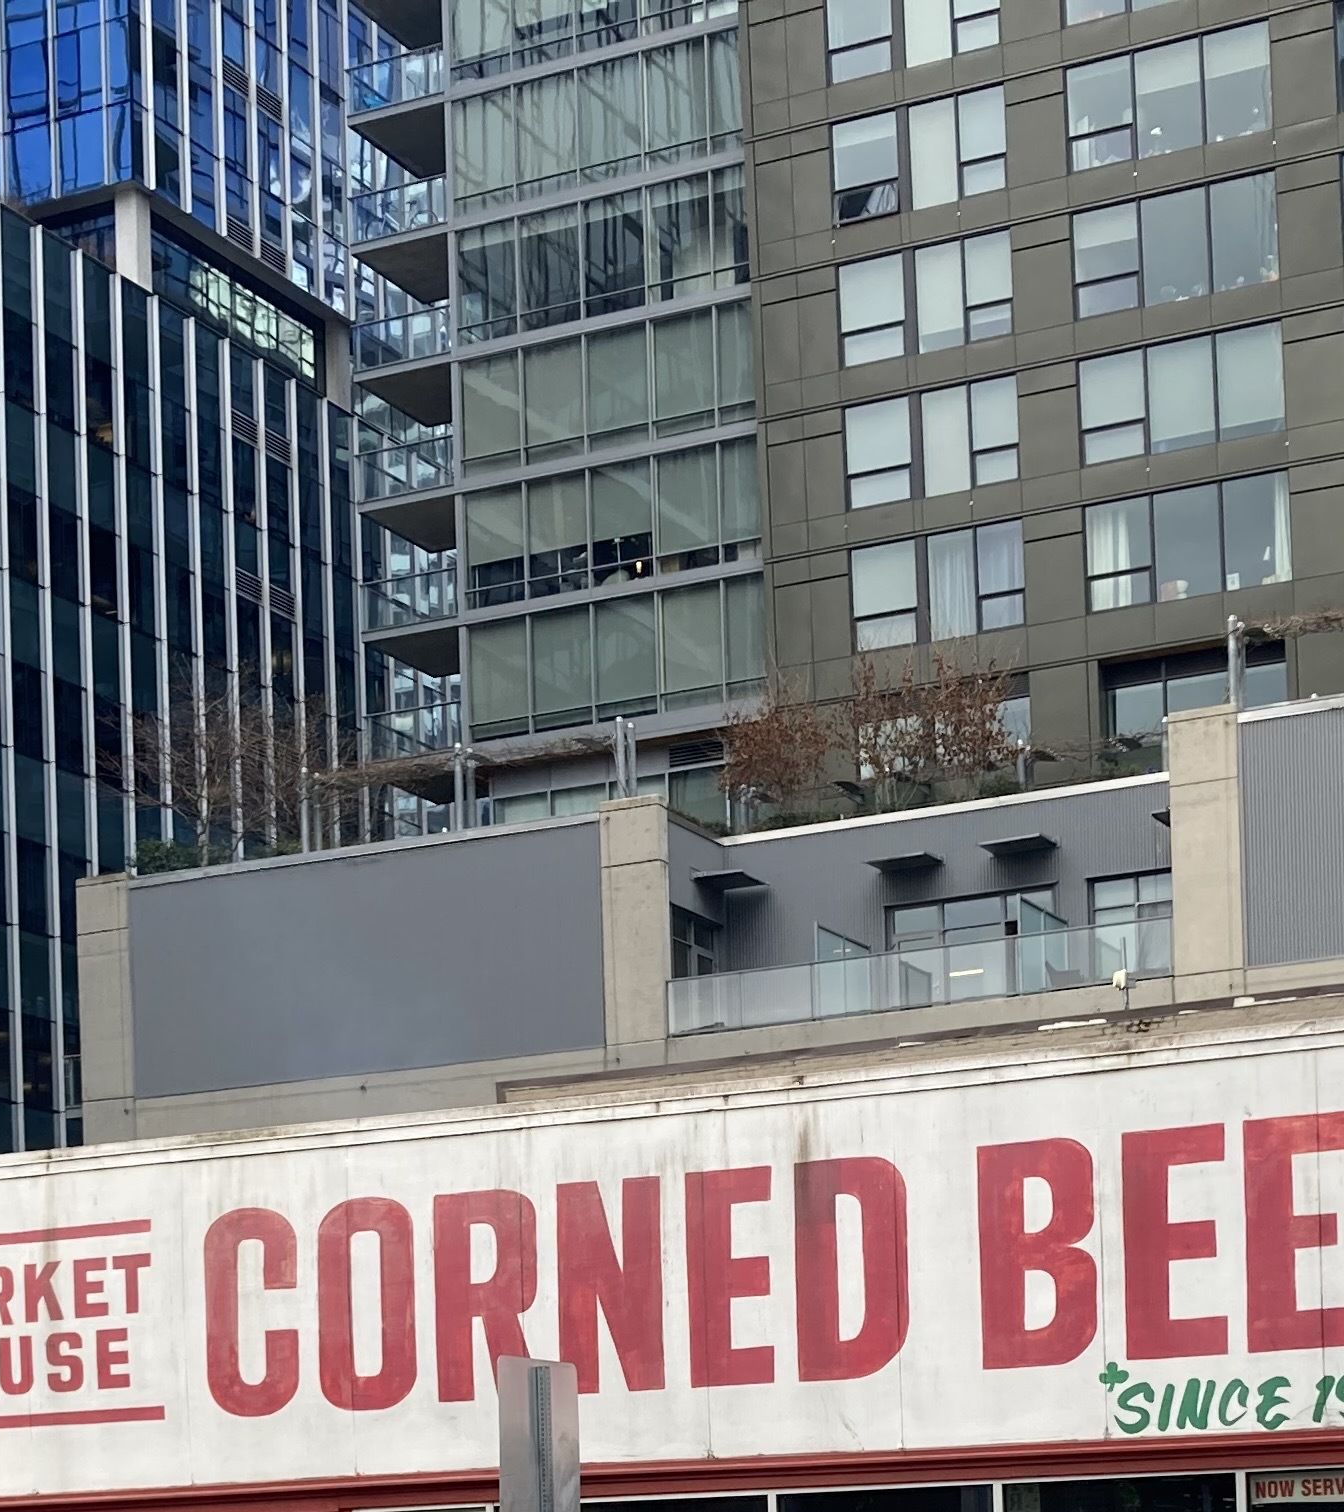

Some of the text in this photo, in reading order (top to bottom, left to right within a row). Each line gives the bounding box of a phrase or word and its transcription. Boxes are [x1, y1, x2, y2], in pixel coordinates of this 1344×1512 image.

[203, 1156, 910, 1418] CORNED
[1112, 1374, 1297, 1434] SINCE
[1255, 1479, 1296, 1499] NOW
